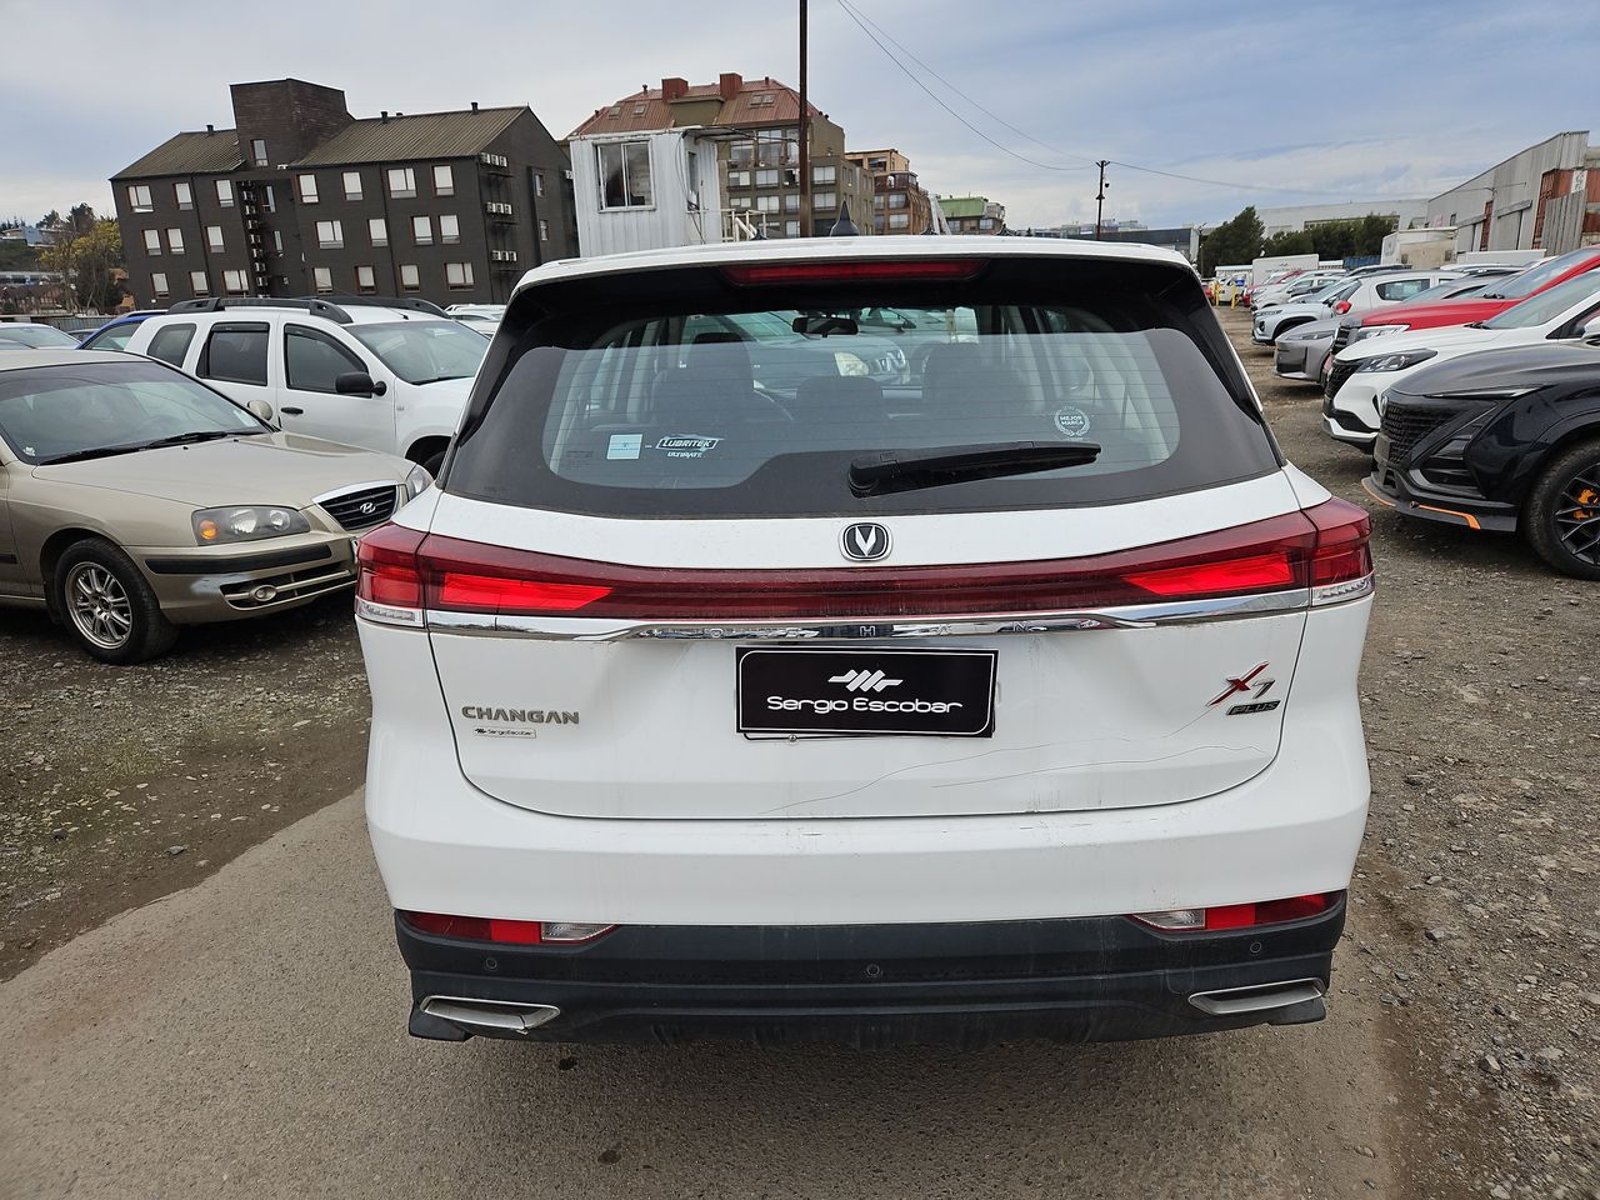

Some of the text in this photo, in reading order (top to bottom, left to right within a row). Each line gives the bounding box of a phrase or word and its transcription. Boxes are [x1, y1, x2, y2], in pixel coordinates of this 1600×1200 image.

[662, 439, 712, 447] LUBRITEK
[1205, 661, 1276, 707] X7
[766, 695, 963, 715] Sergio Escobar
[461, 706, 580, 724] CHANGAN
